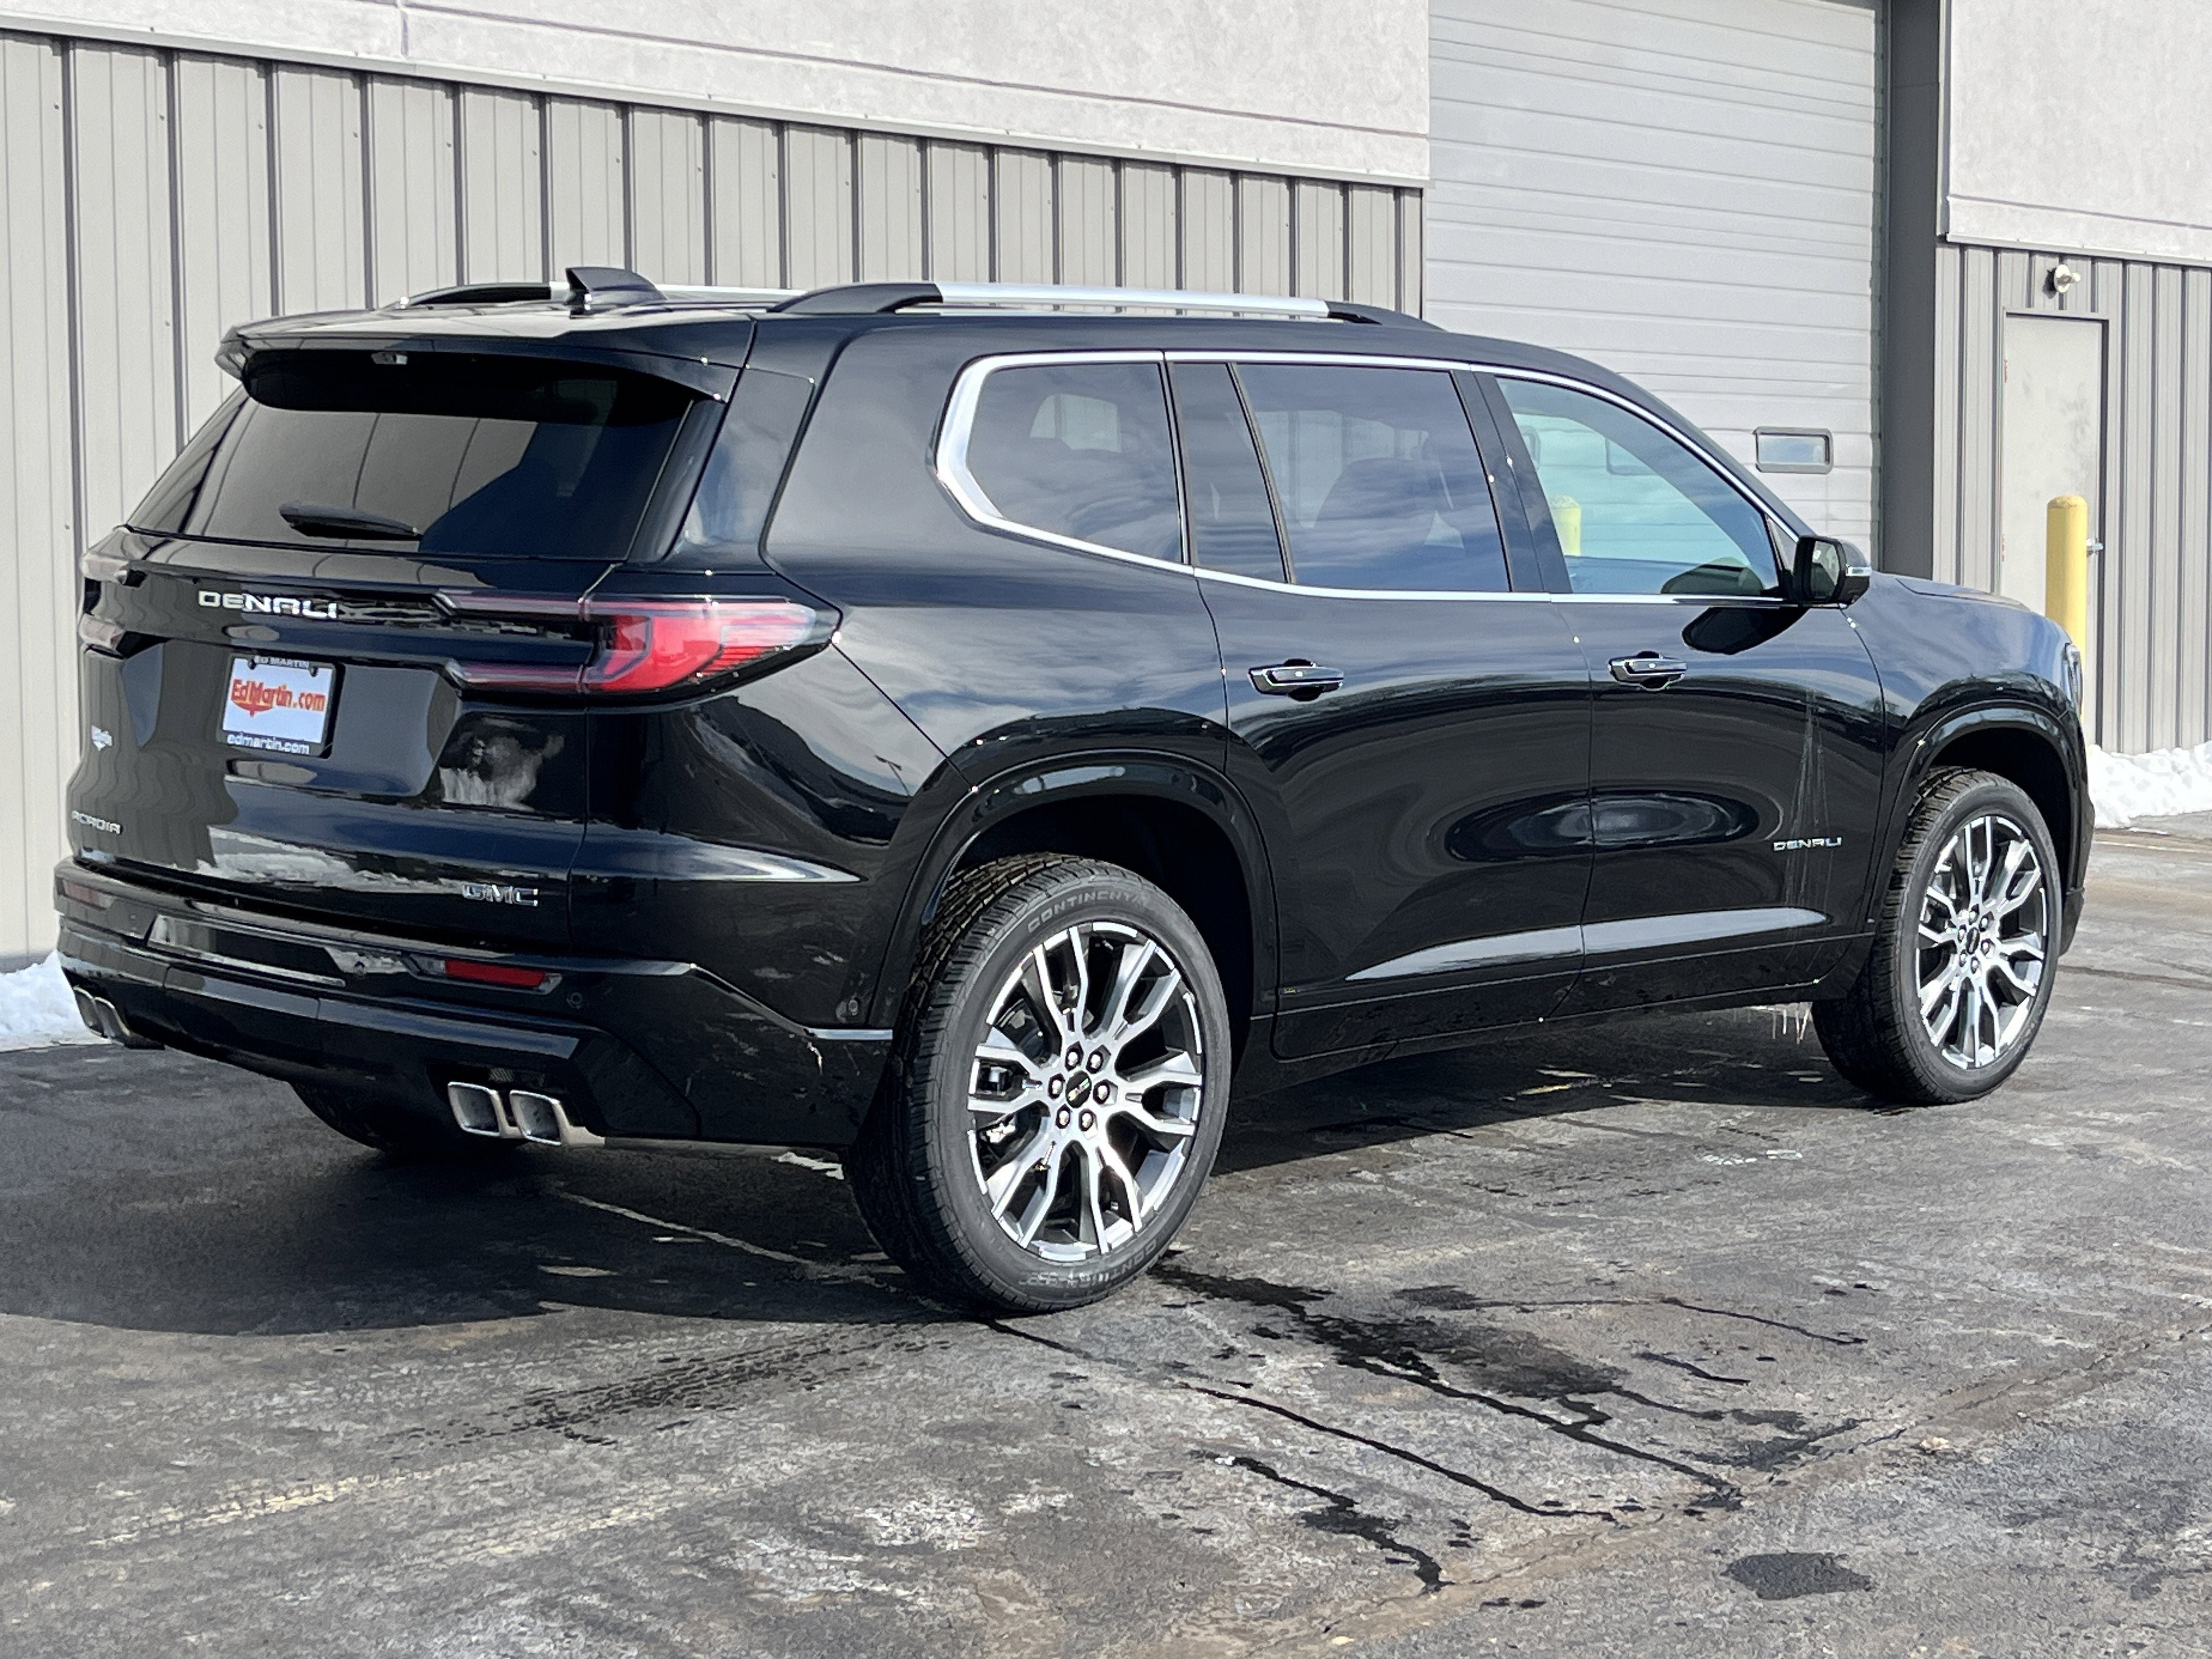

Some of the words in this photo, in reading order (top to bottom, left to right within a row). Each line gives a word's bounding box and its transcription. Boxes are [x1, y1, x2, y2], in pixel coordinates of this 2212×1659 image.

[198, 590, 337, 619] DENALI
[232, 679, 325, 713] EdMartin.com
[227, 732, 309, 755] edmartin.com
[1773, 837, 1842, 851] DENALI
[462, 884, 538, 906] GMC
